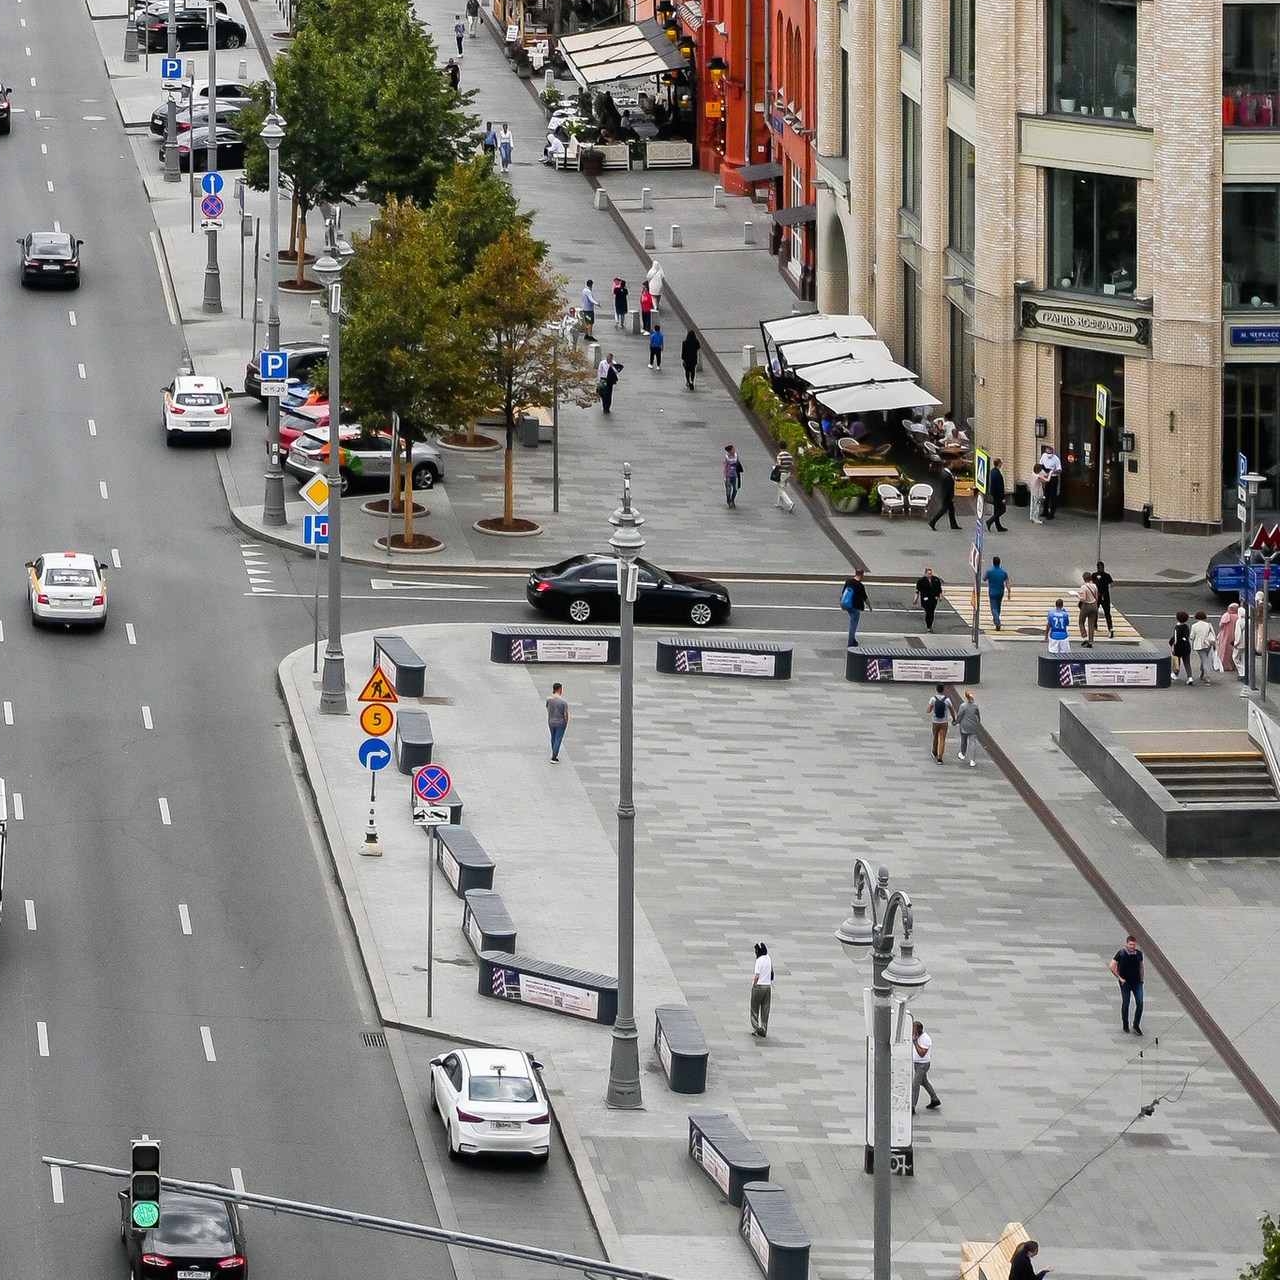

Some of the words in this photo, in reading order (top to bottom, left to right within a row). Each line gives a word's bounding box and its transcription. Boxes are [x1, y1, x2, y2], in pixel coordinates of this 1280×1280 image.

[166, 60, 179, 77] P
[267, 354, 284, 377] P
[1249, 523, 1280, 551] М
[1052, 616, 1065, 630] 21
[373, 712, 382, 726] 5
